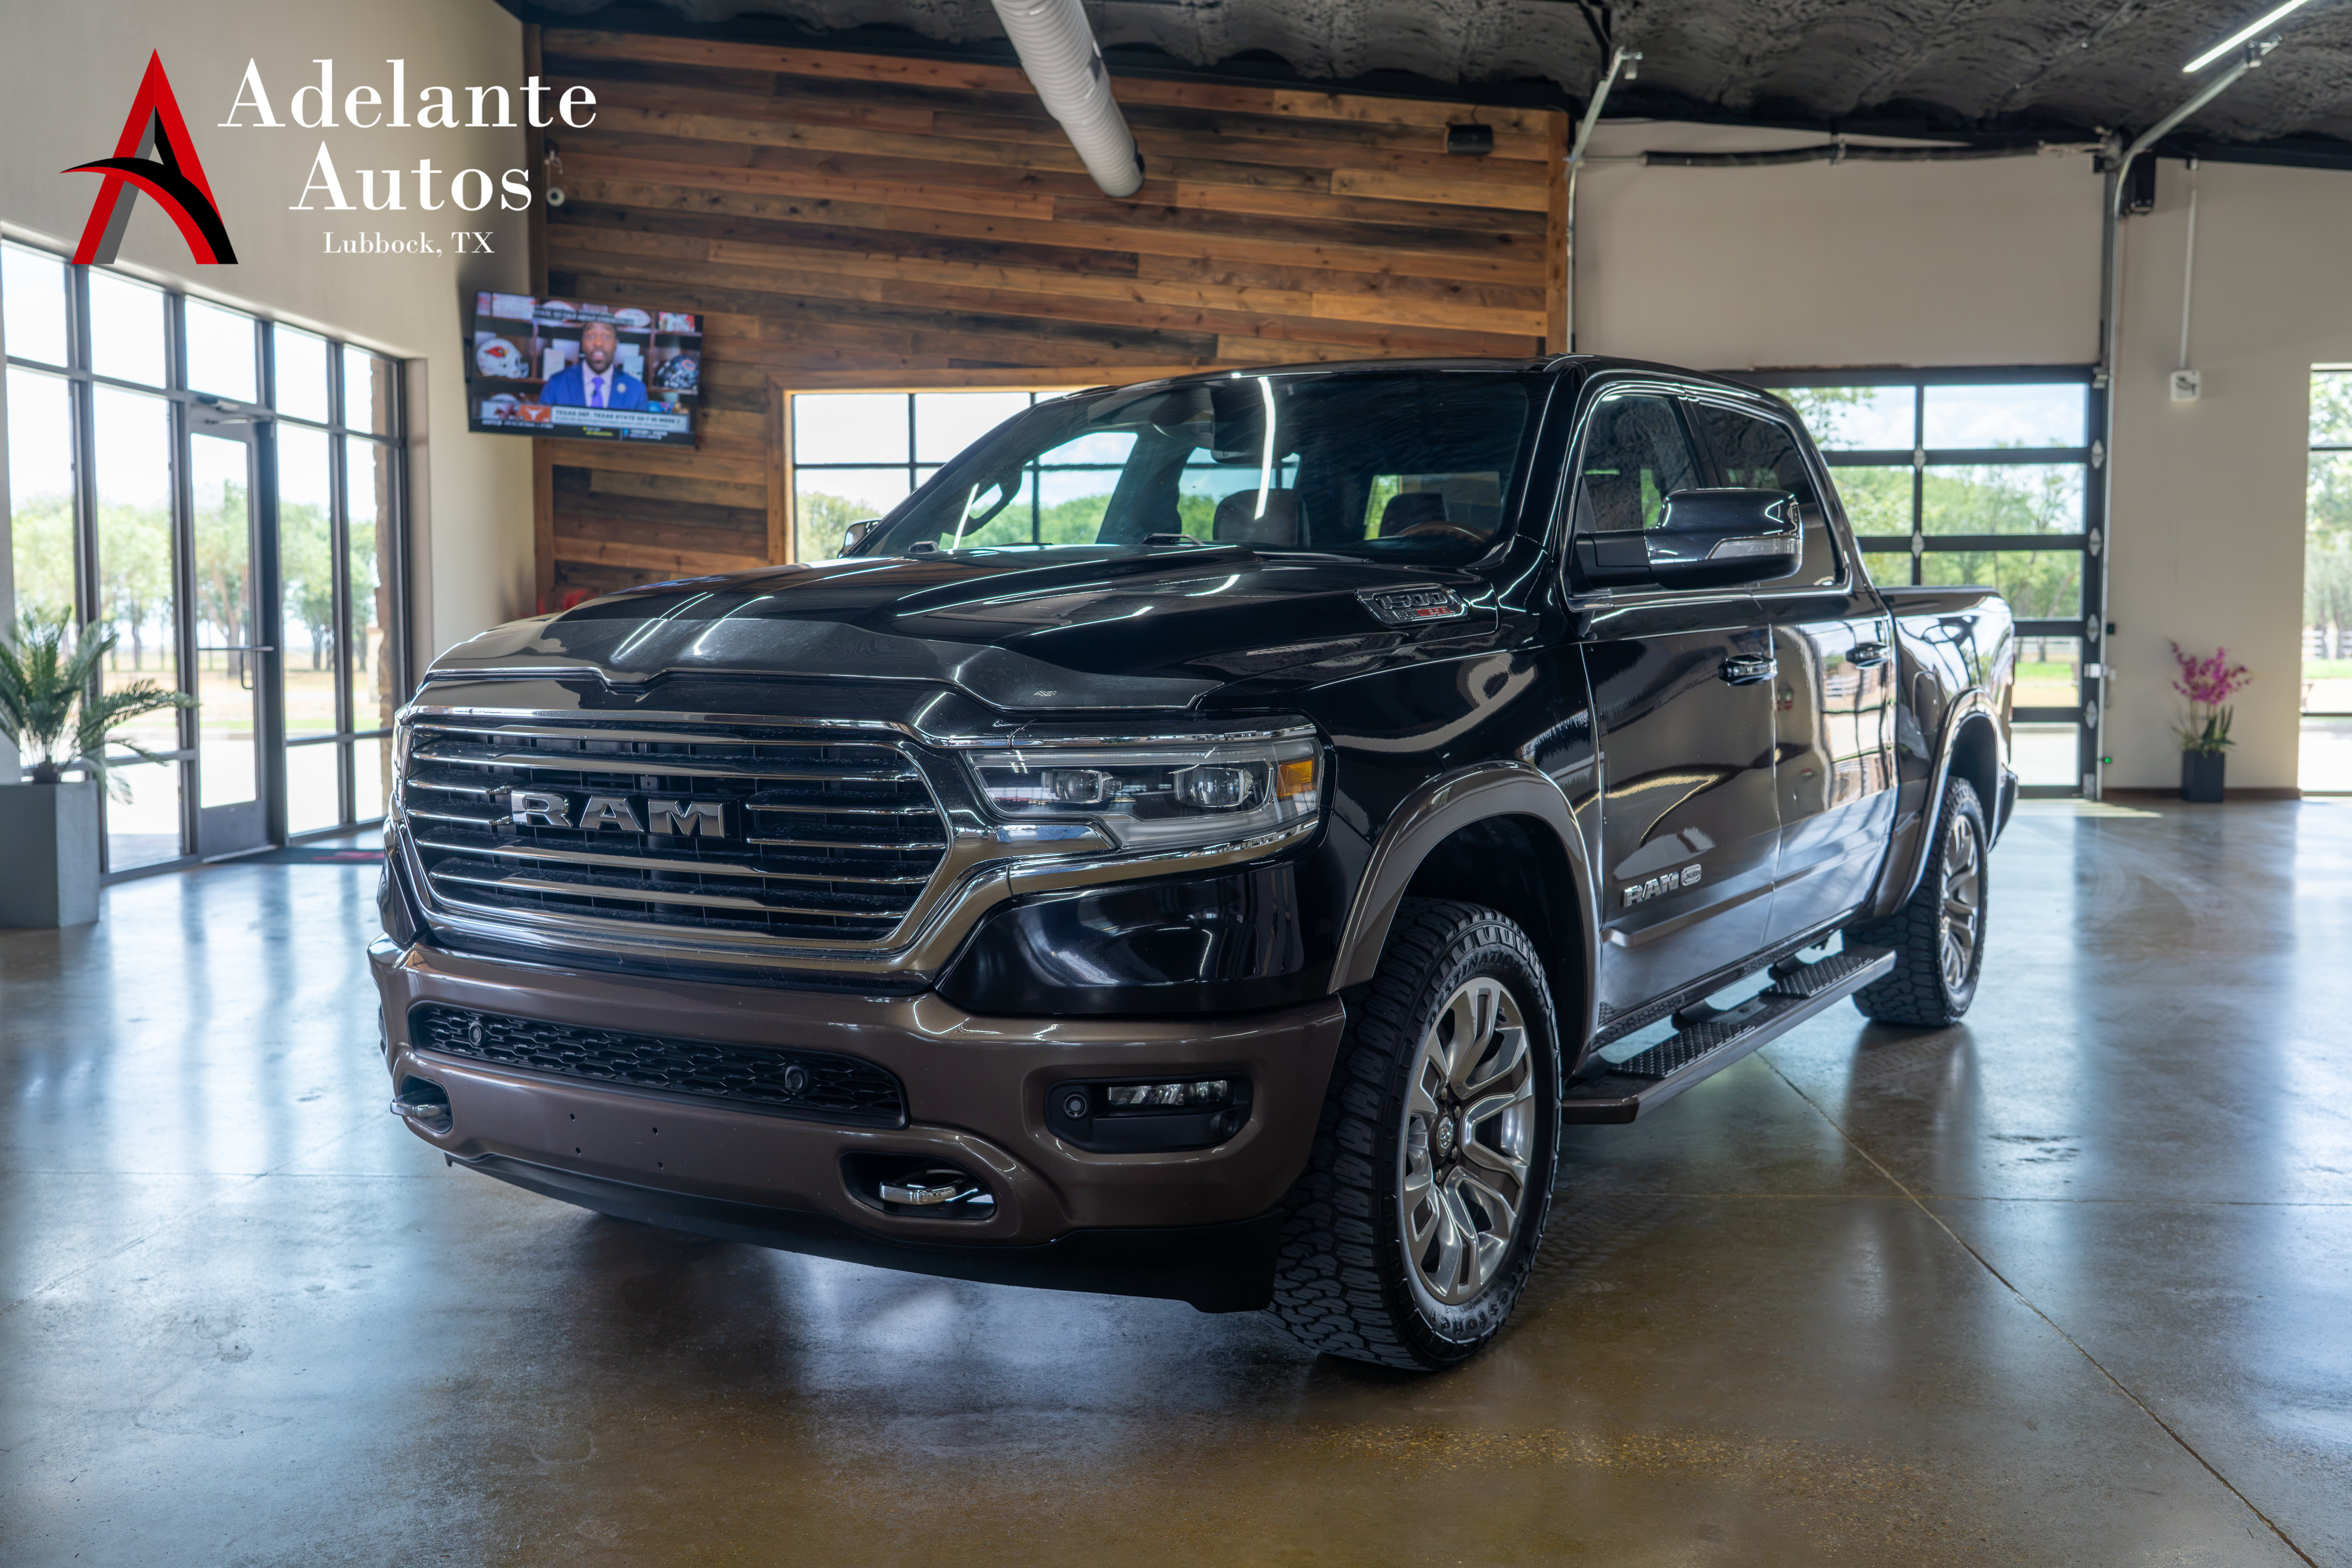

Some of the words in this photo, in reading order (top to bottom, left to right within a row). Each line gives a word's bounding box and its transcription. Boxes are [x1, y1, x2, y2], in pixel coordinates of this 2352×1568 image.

[1376, 593, 1448, 609] 1500
[511, 790, 725, 838] RAM
[1683, 870, 1701, 881] LONGHORN
[1624, 872, 1679, 908] RAM
